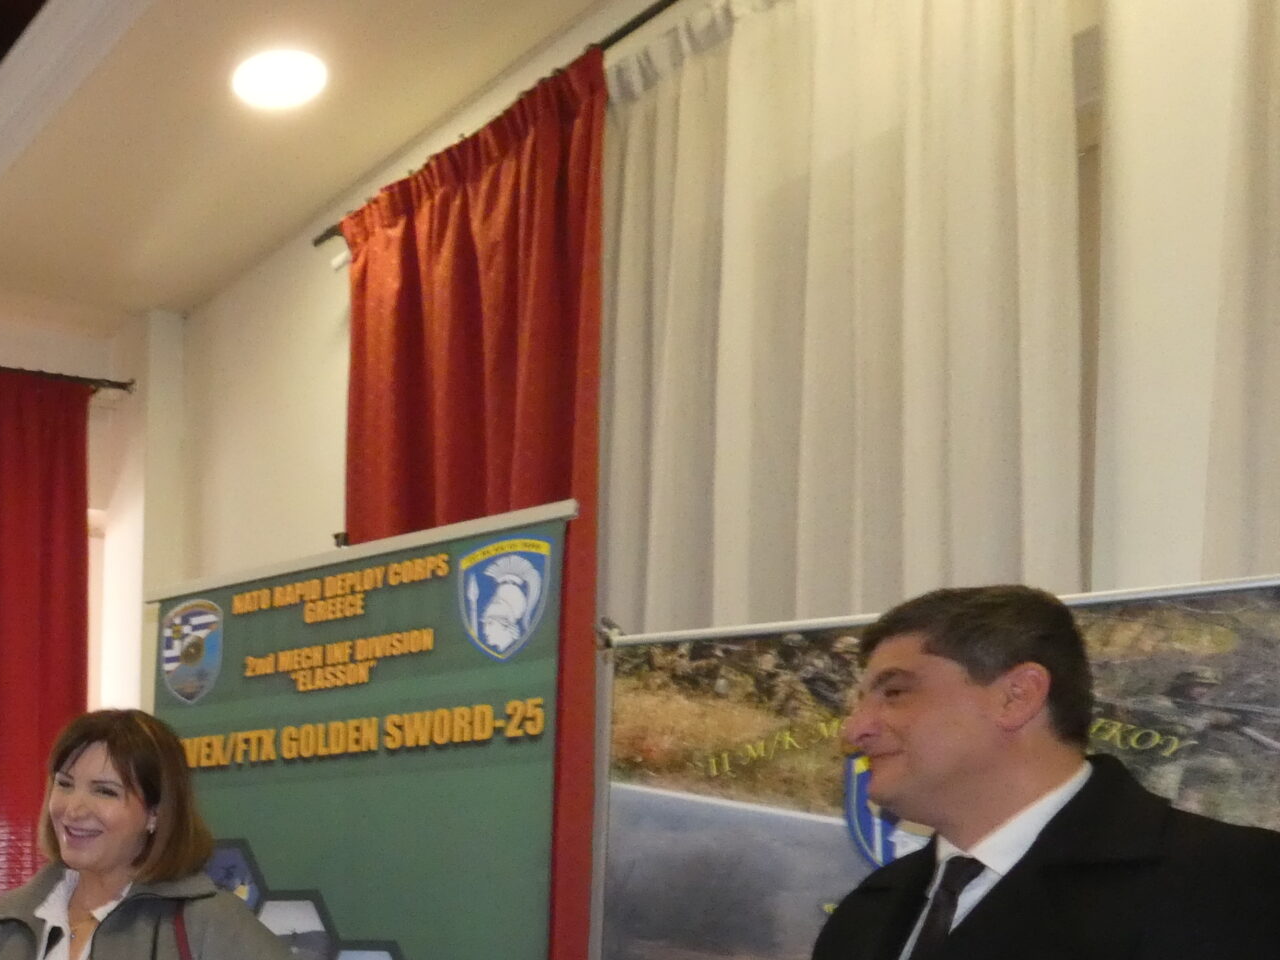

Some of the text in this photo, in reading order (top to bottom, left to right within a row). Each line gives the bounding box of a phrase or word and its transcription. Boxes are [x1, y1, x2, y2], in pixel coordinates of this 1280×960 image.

[231, 588, 271, 615] NATO
[273, 579, 321, 608] RAPID
[323, 566, 386, 598] DEPLOY
[387, 553, 450, 586] CORPS
[303, 593, 365, 624] GREECE
[354, 628, 435, 662] DIVISION
[280, 717, 379, 760] GOLDEN
[383, 697, 545, 750] SWORD-25
